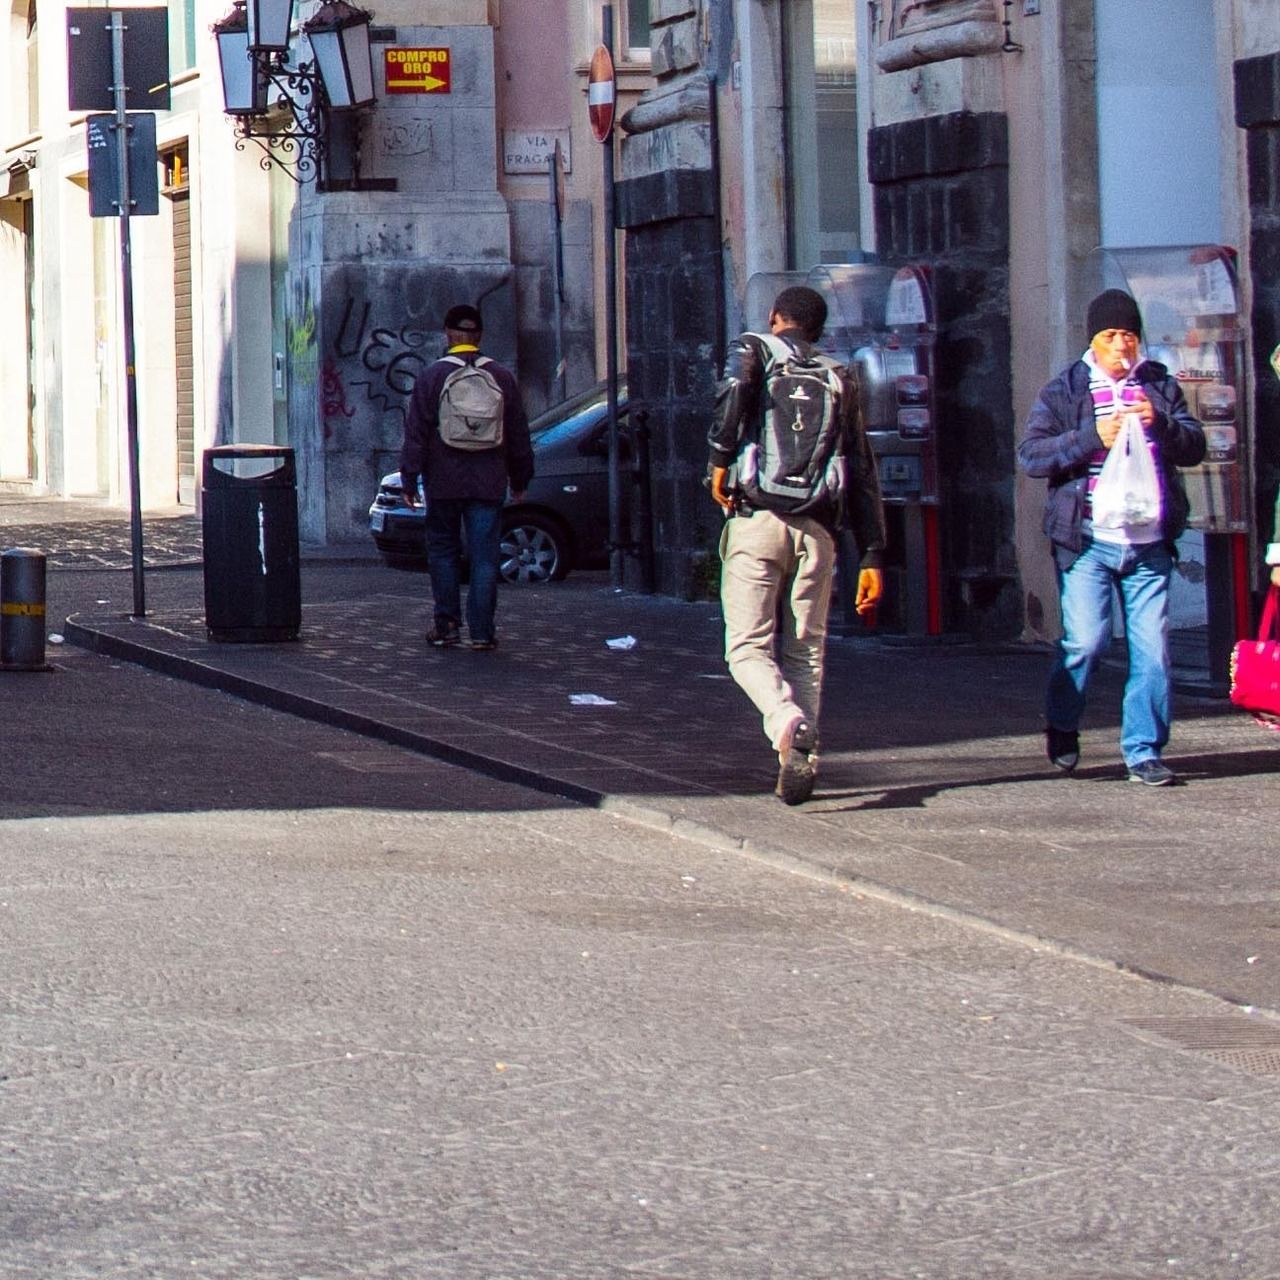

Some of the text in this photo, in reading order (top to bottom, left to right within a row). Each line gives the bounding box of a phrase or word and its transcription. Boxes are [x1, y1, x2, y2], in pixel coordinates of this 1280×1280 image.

[387, 50, 447, 63] COMPRO
[403, 62, 432, 74] ORO
[527, 136, 548, 147] VIA
